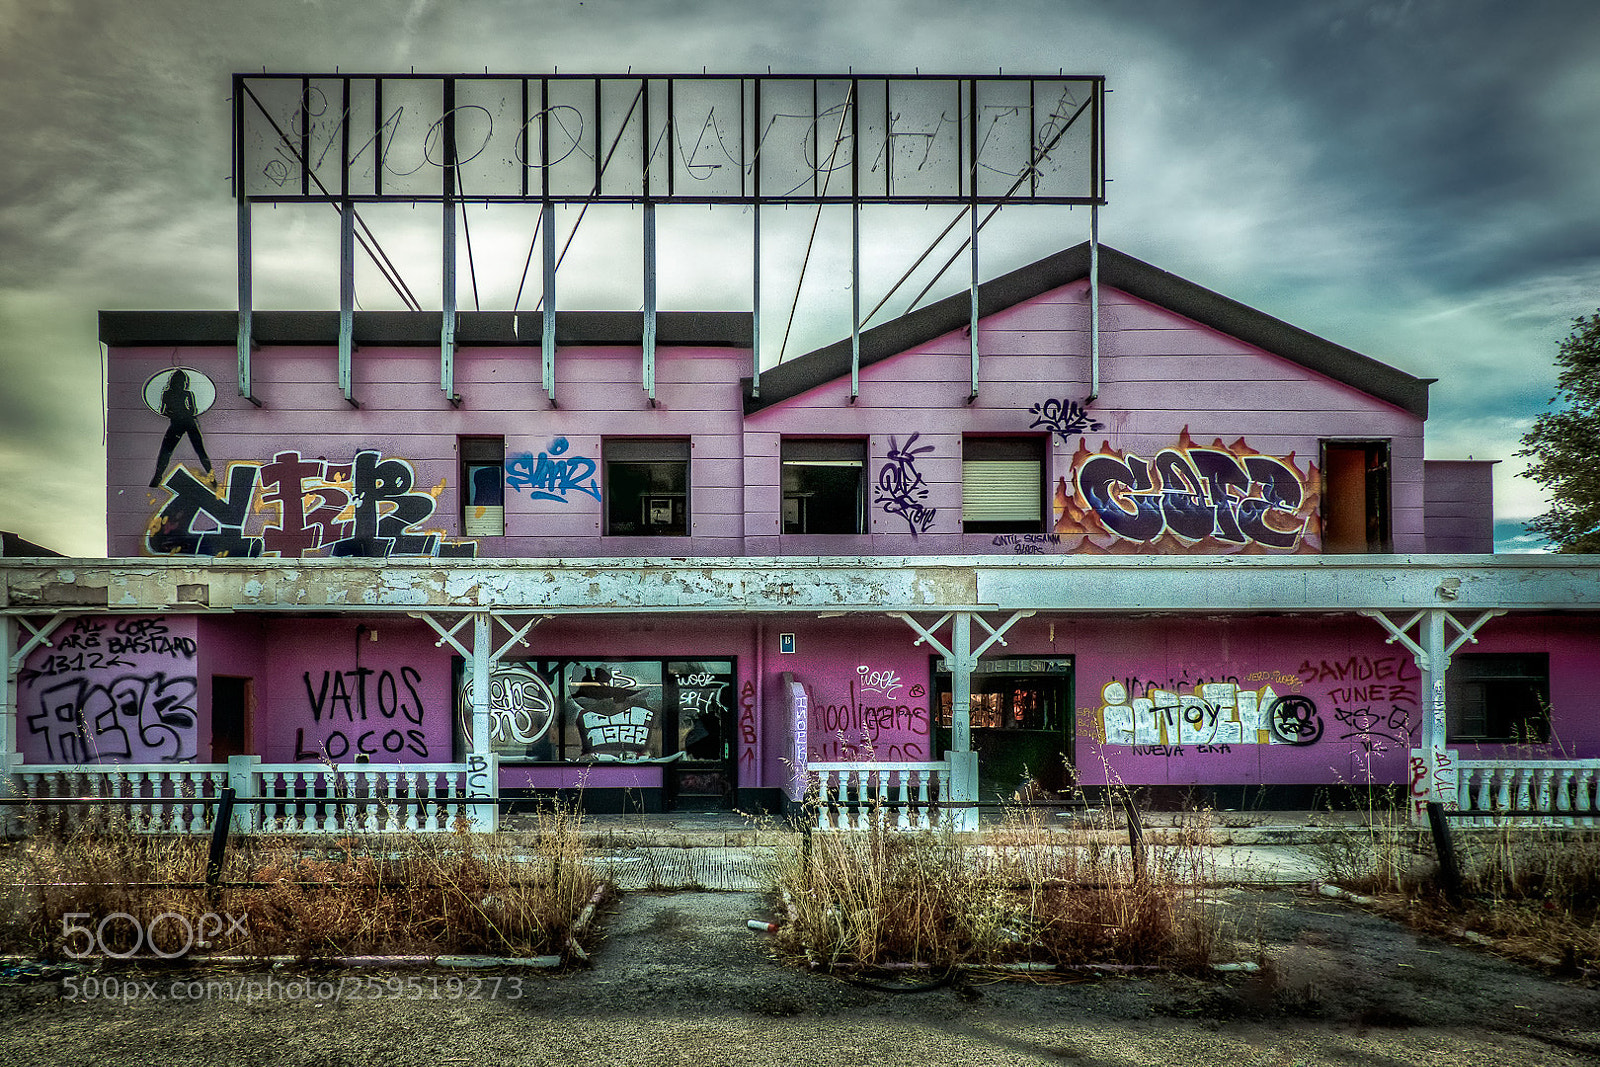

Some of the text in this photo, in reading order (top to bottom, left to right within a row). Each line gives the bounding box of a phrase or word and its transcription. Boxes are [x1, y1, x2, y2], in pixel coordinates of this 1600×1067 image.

[115, 617, 169, 635] COPS
[58, 633, 197, 659] ARE BASTARD
[41, 652, 108, 676] 1312
[1298, 655, 1421, 684] SAMUEL
[303, 666, 424, 726] VATOS
[1327, 684, 1417, 706] TUNEZ
[808, 681, 930, 743] hooligans
[1149, 704, 1221, 727] TOY
[294, 727, 429, 762] LOCOS
[586, 725, 650, 747] 1922
